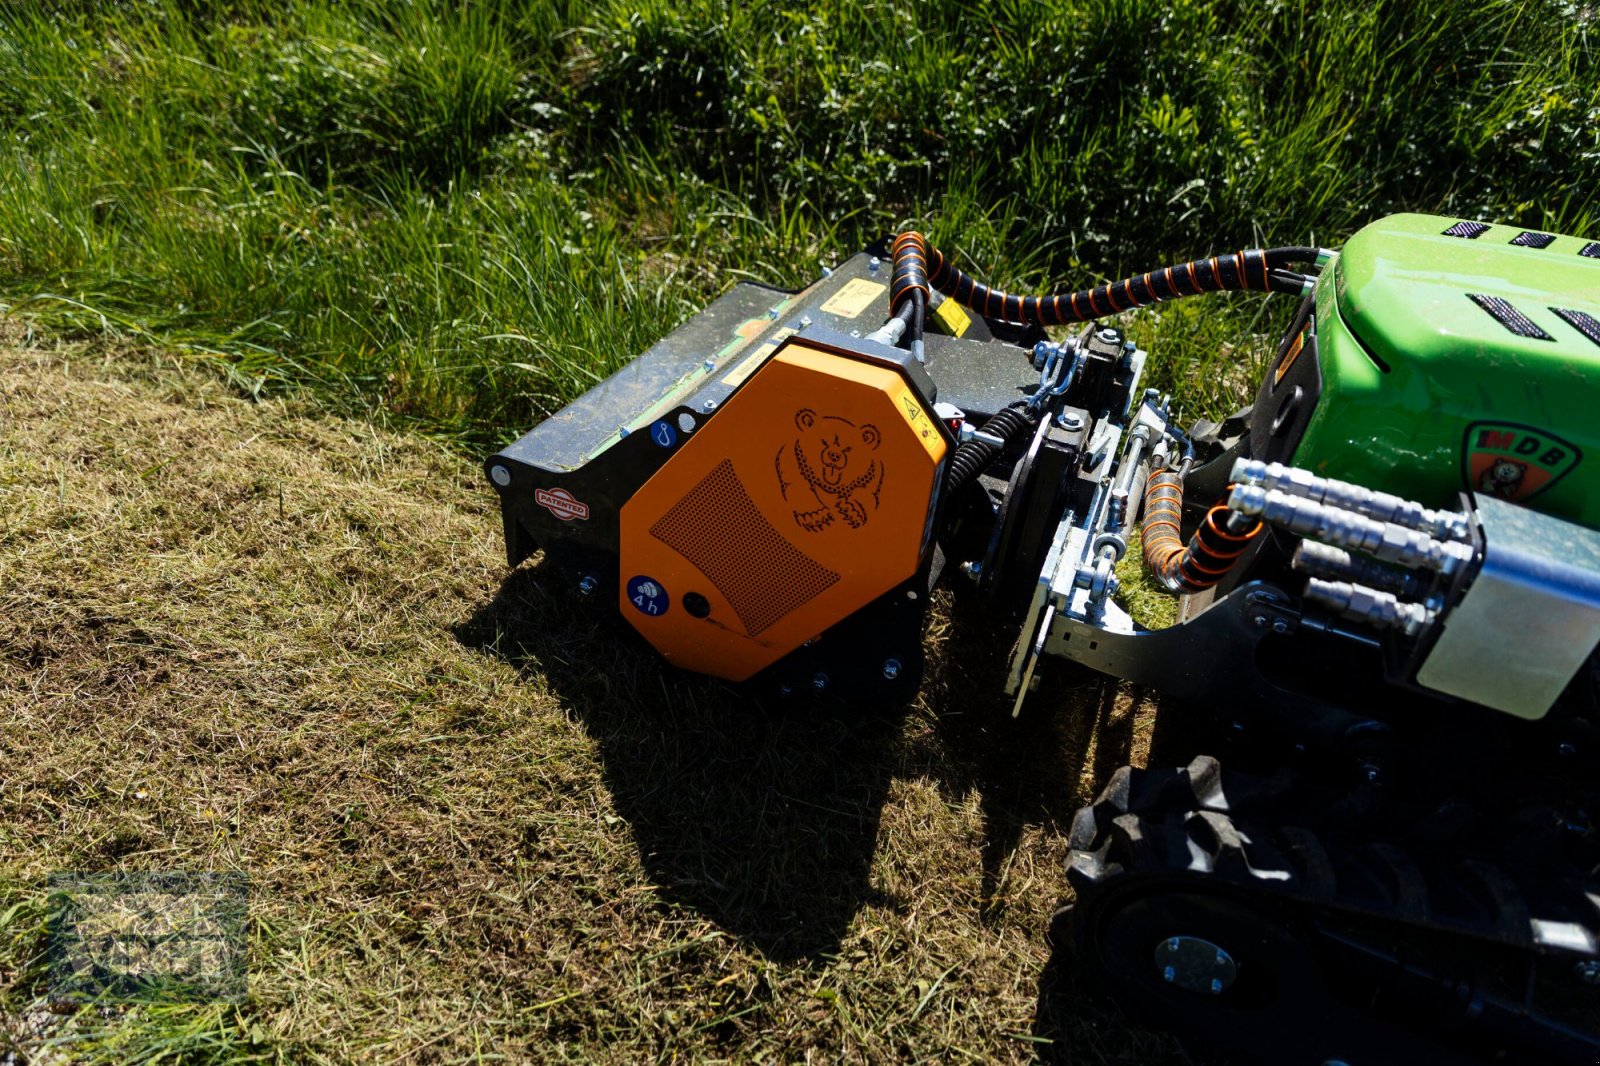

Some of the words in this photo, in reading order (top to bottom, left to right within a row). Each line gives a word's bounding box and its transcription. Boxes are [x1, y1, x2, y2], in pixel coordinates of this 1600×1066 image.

[1477, 430, 1565, 465] MDB
[540, 494, 584, 514] PATENTED
[633, 595, 643, 607] 4
[647, 600, 658, 615] h
